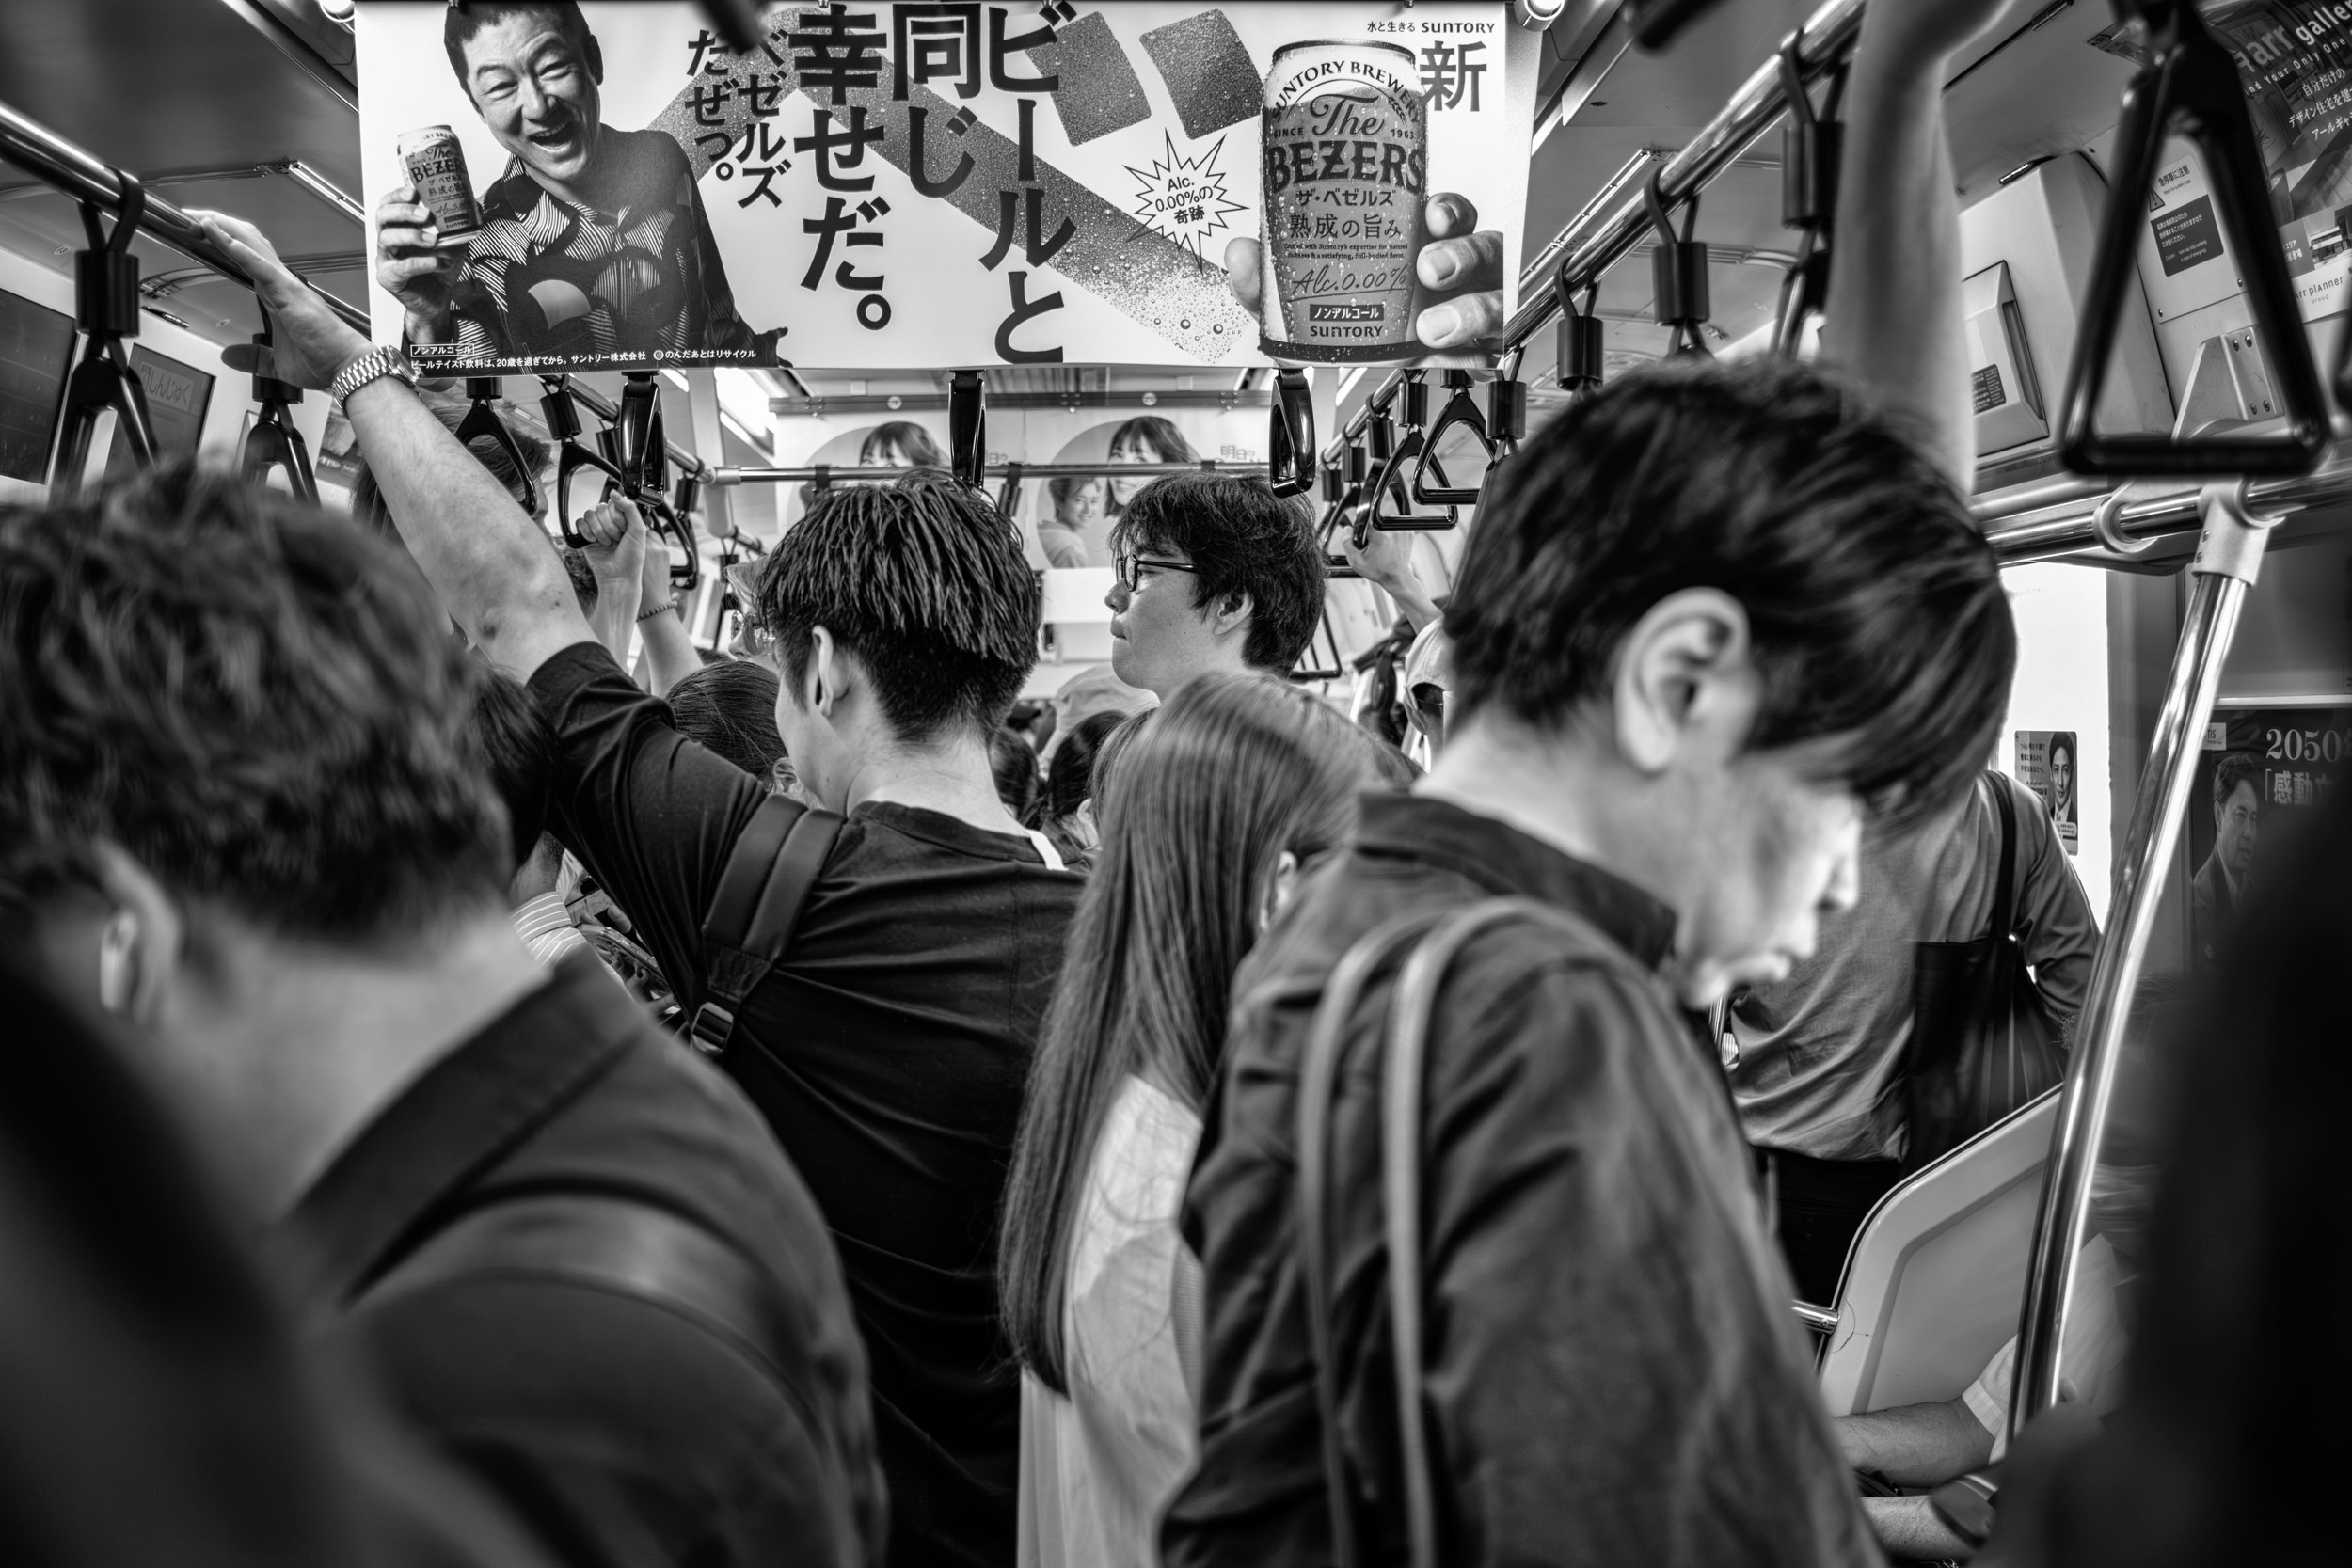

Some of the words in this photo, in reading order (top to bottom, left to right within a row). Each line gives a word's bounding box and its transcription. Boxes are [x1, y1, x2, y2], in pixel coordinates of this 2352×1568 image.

[1367, 21, 1416, 33] 水と生きる
[1421, 22, 1496, 34] SUNTORY
[1419, 40, 1487, 112] 新
[2302, 68, 2346, 97] 自分だけの
[893, 3, 981, 198] 同じ
[1272, 60, 1346, 123] SUNTORY
[1310, 93, 1385, 136] The
[1274, 127, 1304, 139] SINCE
[1391, 128, 1415, 140] 1963
[788, 3, 892, 330] 幸せだ。
[1269, 140, 1422, 195] BEZERS
[978, 1, 1077, 364] ビールと
[1168, 176, 1195, 192] Alc.
[1155, 186, 1213, 212] 0.00%の
[1295, 188, 1396, 207] ザ・ベゼルズ
[1174, 205, 1205, 224] 奇跡
[1289, 213, 1401, 239] 熟成の旨み
[1314, 307, 1379, 319] ノンアルコール
[1310, 325, 1384, 338] SUNTORY
[413, 346, 473, 355] ノンアルコール
[571, 351, 646, 363] サントリー株式会社
[665, 349, 756, 359] のんだあとはリサイクル
[986, 449, 1008, 465] 日の
